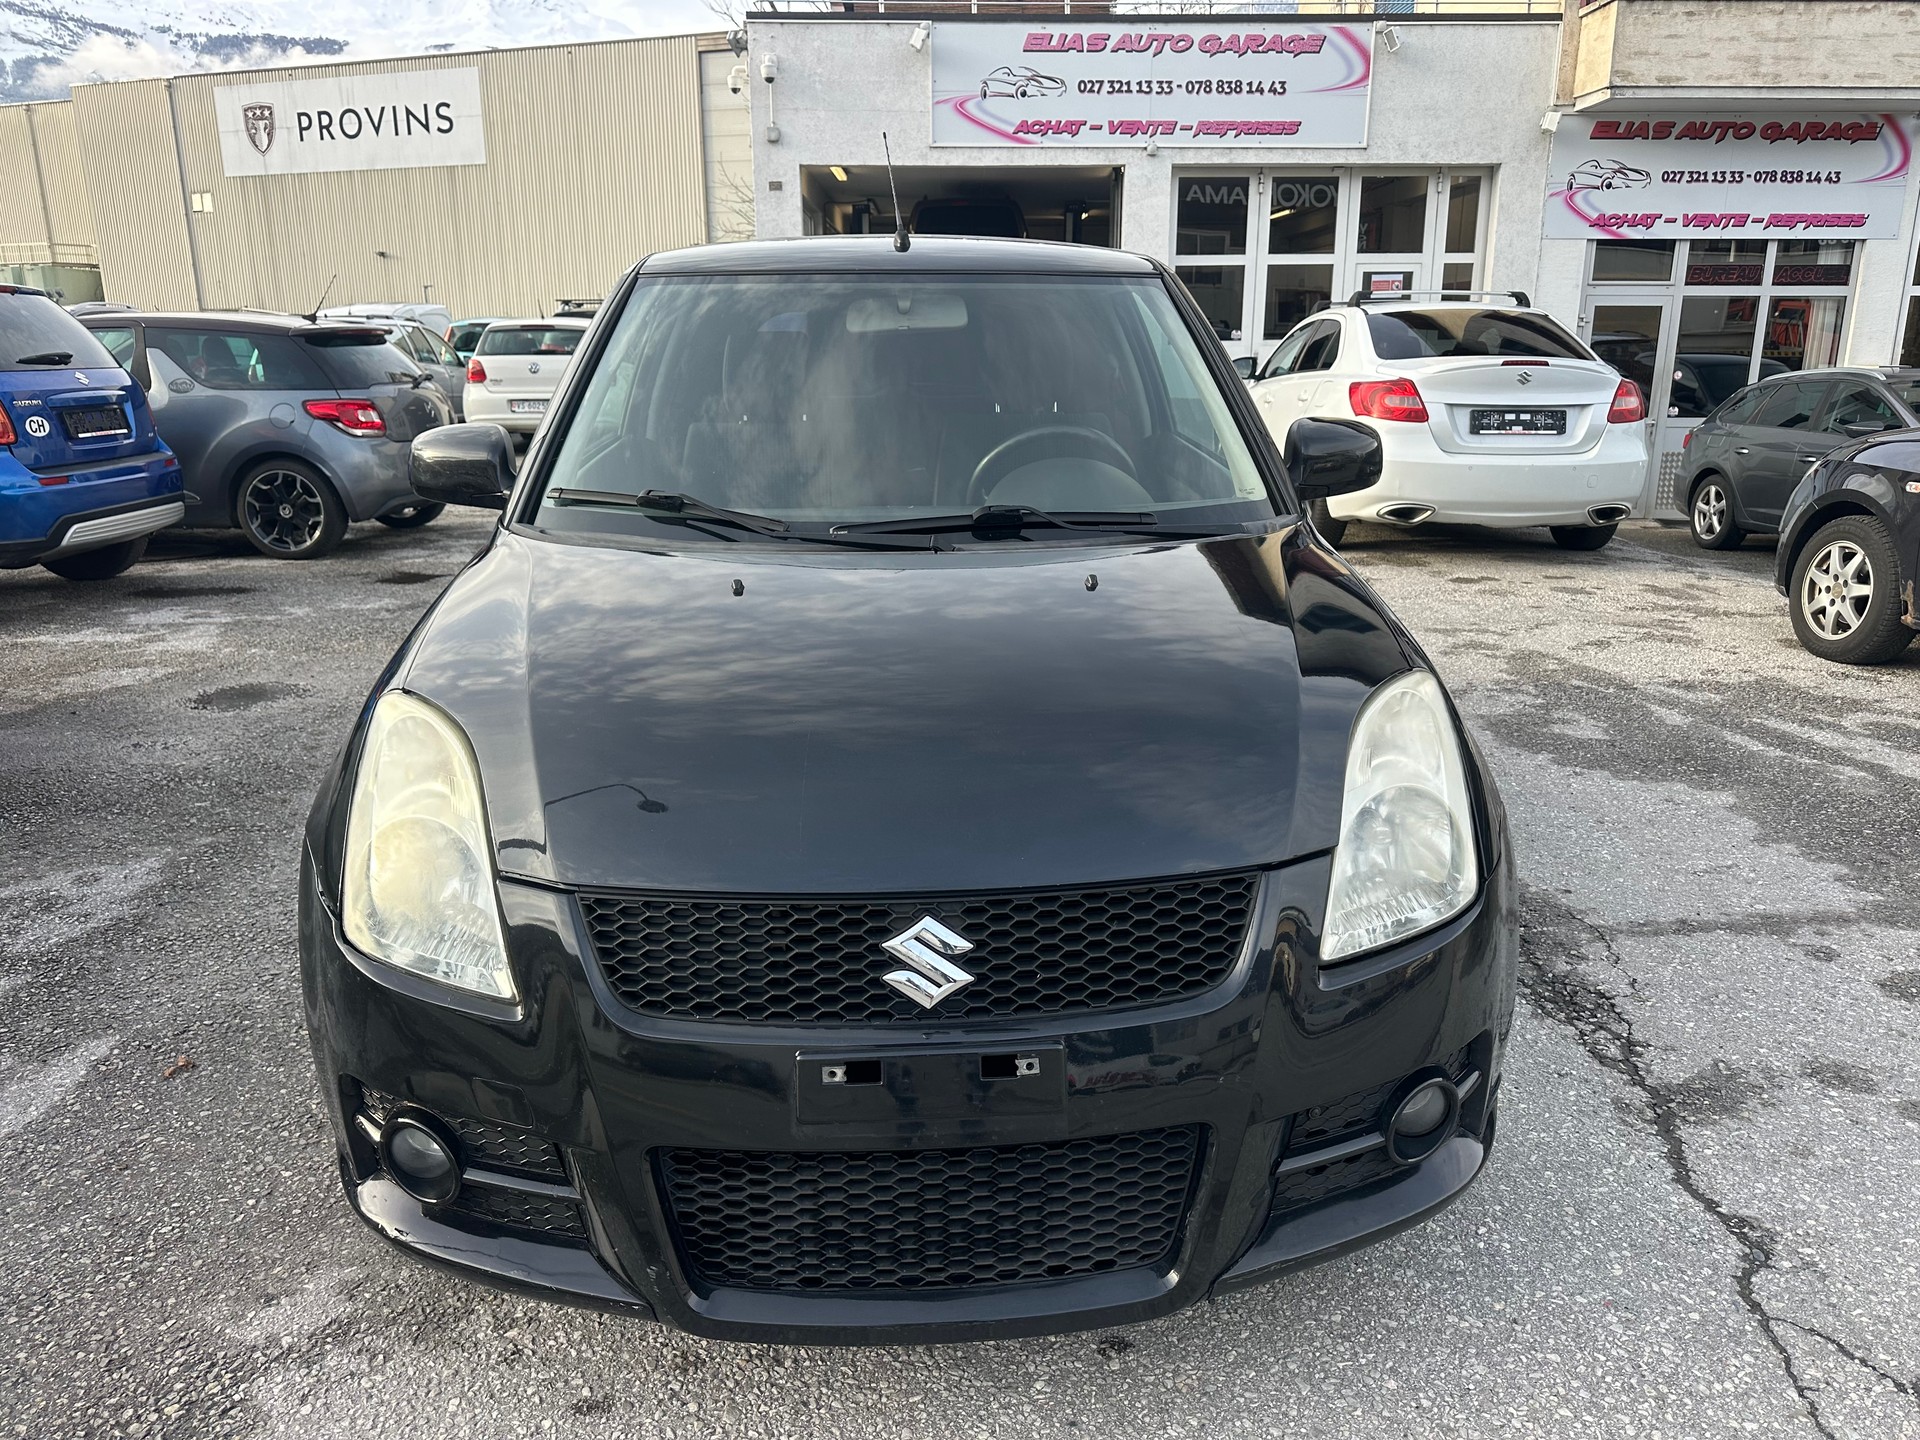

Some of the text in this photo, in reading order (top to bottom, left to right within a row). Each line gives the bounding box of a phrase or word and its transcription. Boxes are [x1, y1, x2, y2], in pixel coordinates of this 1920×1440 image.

[1023, 33, 1327, 58] ELIAS AUTO GARAGE
[1077, 79, 1104, 95] 027
[1106, 79, 1133, 95] 321
[1135, 79, 1153, 95] 13
[1155, 79, 1174, 95] 33
[1185, 79, 1213, 95] 078
[1215, 79, 1243, 95] 838
[1245, 79, 1264, 95] 14
[1267, 79, 1287, 95] 43
[297, 102, 454, 142] PROVINS
[1012, 120, 1087, 137] ACHAT
[1107, 120, 1178, 138] VENTE
[1193, 120, 1302, 138] REPRISES
[1590, 121, 1884, 145] ELIAS AUTO GARAGE
[1661, 170, 1685, 184] 027
[1686, 170, 1709, 184] 321
[1711, 170, 1728, 184] 13
[1728, 170, 1744, 184] 33
[1753, 170, 1778, 184] 078
[1779, 170, 1804, 184] 838
[1805, 170, 1822, 184] 14
[1824, 170, 1841, 184] 43
[1589, 213, 1662, 230] ACHAT
[1682, 213, 1750, 231] VENTE
[1763, 213, 1870, 231] REPRISES
[1687, 265, 1762, 283] BUREAU
[13, 399, 43, 407] SUZUKI
[29, 419, 46, 434] CH
